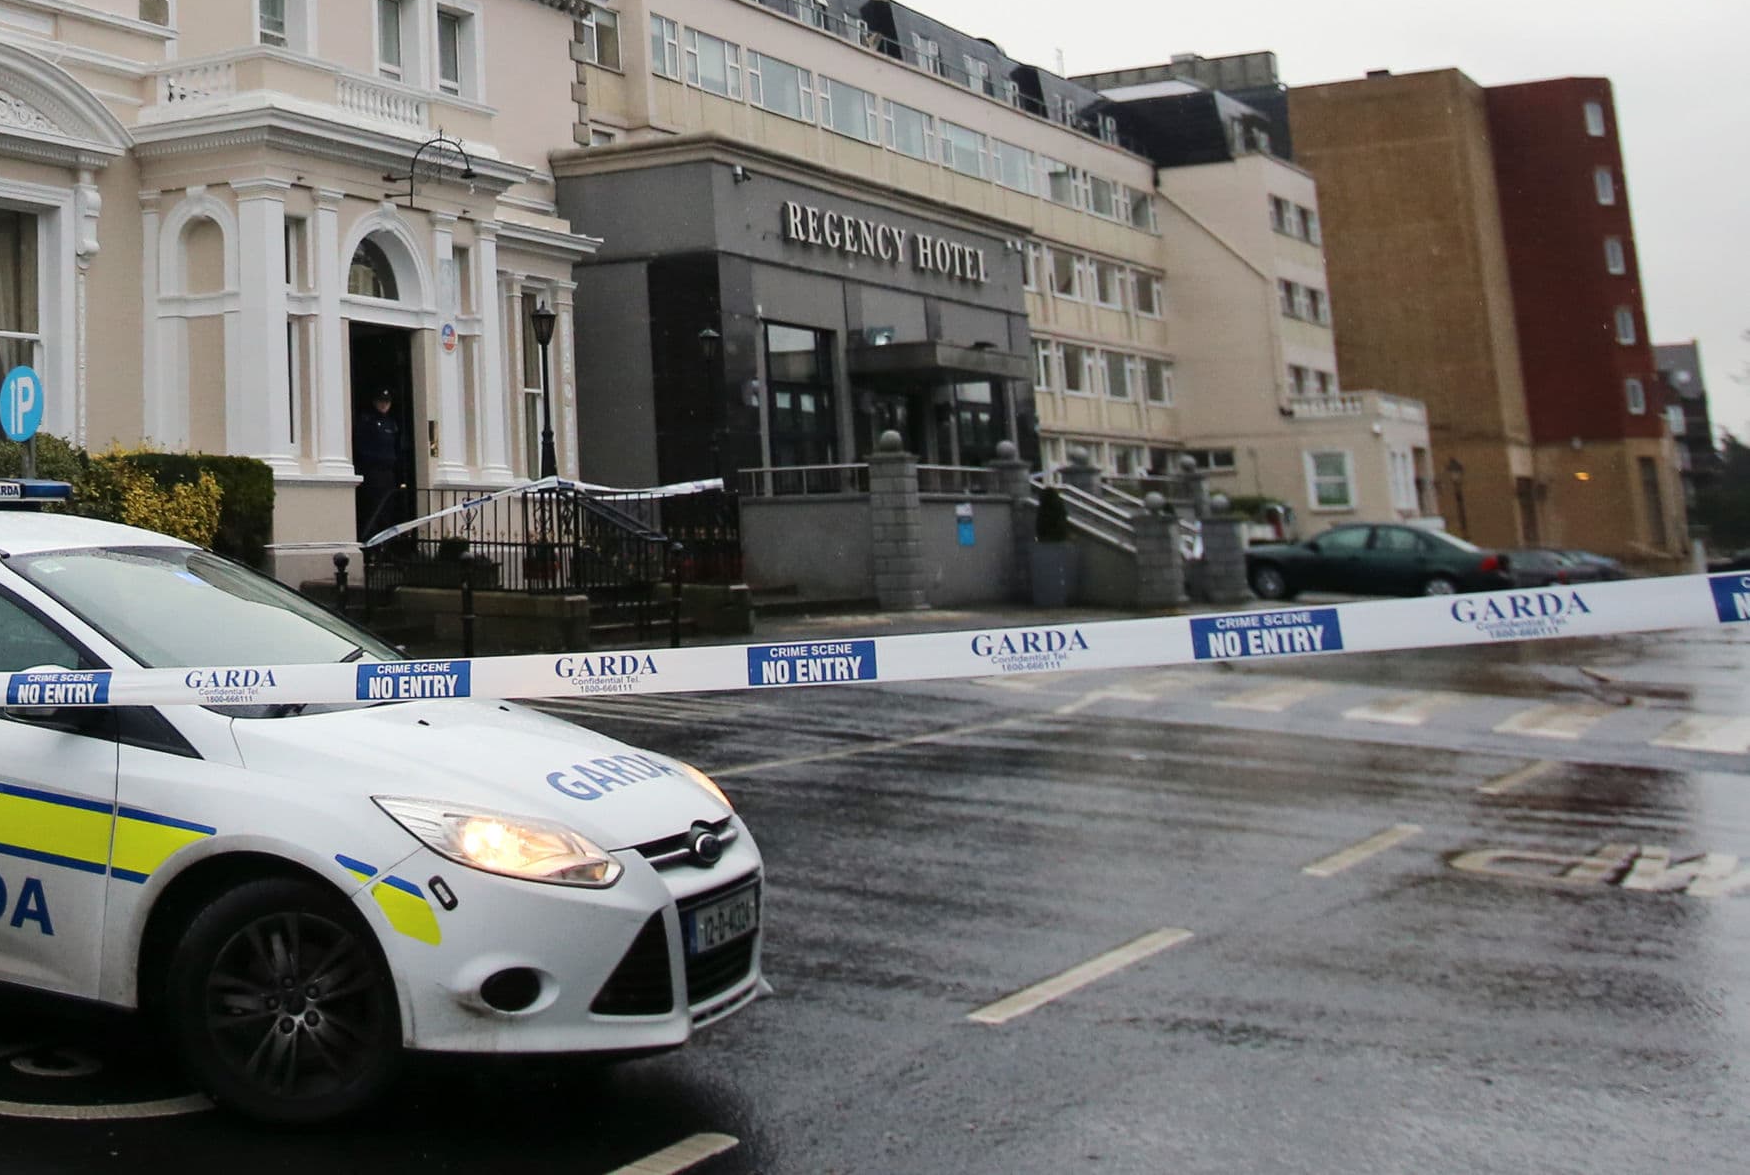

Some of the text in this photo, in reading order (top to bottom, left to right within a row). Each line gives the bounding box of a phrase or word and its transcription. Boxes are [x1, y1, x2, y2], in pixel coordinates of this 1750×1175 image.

[783, 200, 990, 284] REGENCY HOTEL
[17, 376, 35, 434] P
[1451, 591, 1591, 623] GARDA
[1732, 592, 1750, 620] N
[1215, 612, 1312, 629] CRIME SCENE
[769, 643, 853, 658] CRIME SCENE
[971, 629, 1089, 657] GARDA
[1207, 625, 1324, 658] NO ENTRY
[377, 663, 450, 674] CRIME SCENE
[555, 654, 658, 678] GARDA
[762, 656, 863, 685] NO ENTRY
[991, 653, 1050, 664] Confidential
[27, 673, 94, 682] CRIME SCENE
[185, 669, 276, 688] GARDA
[368, 674, 458, 699] NO ENTRY
[571, 676, 623, 685] Confidential
[17, 683, 98, 704] NO ENTRY
[546, 754, 684, 801] GARDA
